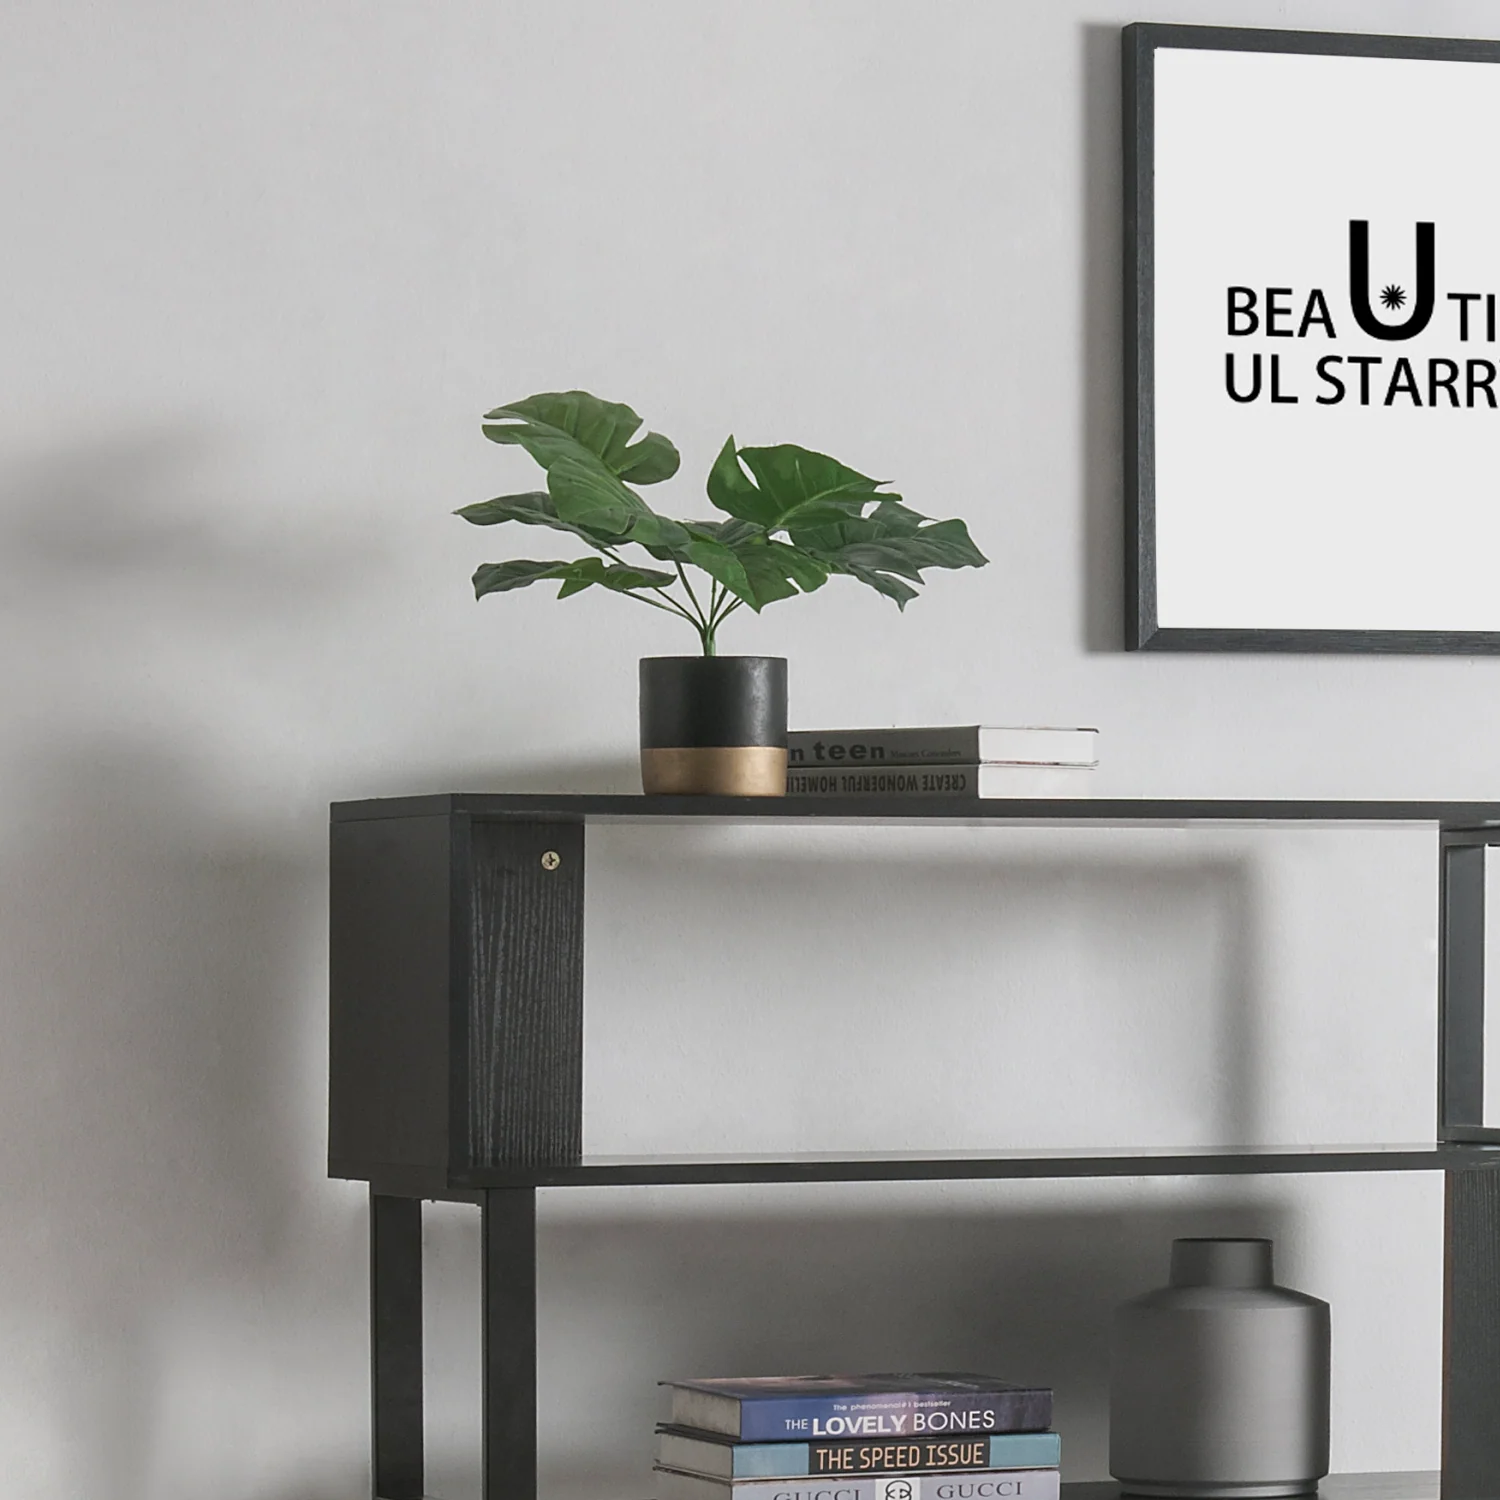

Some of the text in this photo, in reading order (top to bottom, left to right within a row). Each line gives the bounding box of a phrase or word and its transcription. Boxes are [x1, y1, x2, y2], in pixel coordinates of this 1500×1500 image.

[1225, 353, 1299, 404] UL
[813, 740, 885, 761] teen
[842, 775, 918, 793] WONDERFUL
[923, 774, 966, 791] CREATE
[832, 1404, 848, 1412] The
[913, 1400, 951, 1409] bestseller
[784, 1410, 995, 1436] THE LOVELY BONES
[816, 1443, 984, 1470] THE SPEED ISSUE
[936, 1481, 1022, 1499] GUCCI
